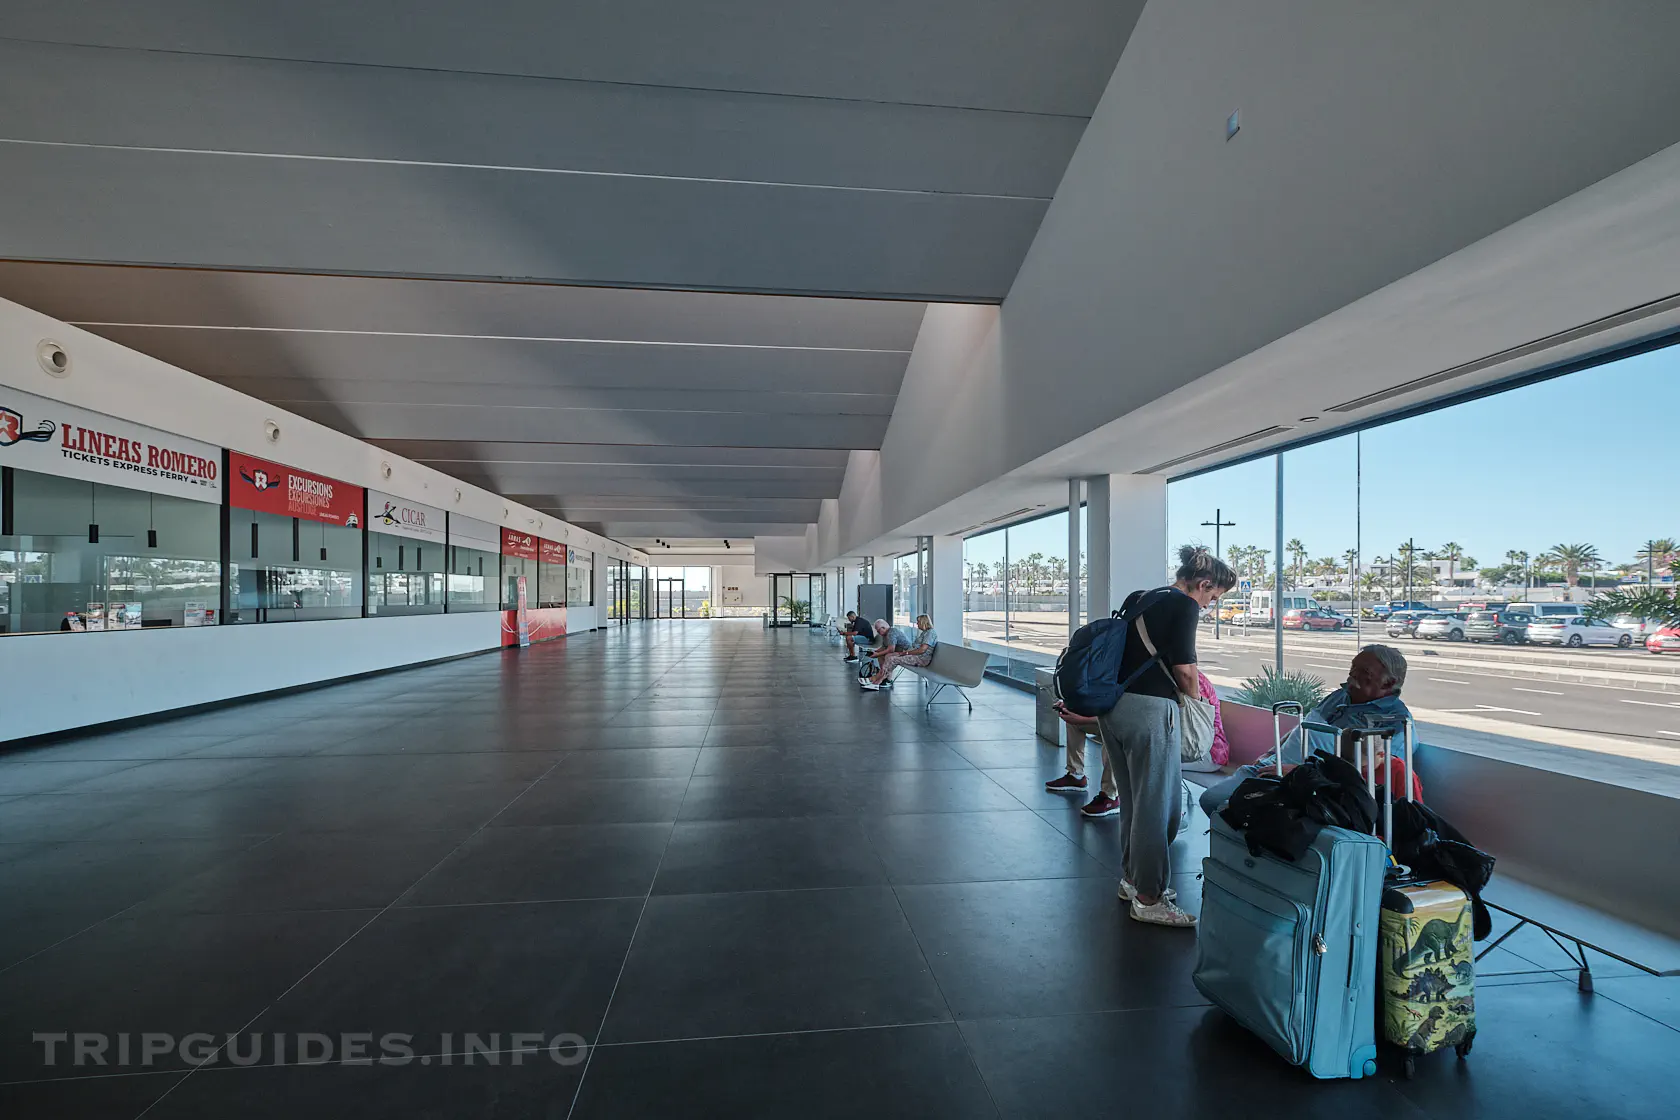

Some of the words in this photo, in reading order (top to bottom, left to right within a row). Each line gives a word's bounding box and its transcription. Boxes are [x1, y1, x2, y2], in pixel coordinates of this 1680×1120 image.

[61, 423, 142, 464] LINEAS
[147, 444, 217, 481] ROMERO
[61, 449, 110, 467] TICKETS
[113, 460, 158, 476] EXPRESS
[160, 470, 189, 483] FERRY
[288, 474, 333, 499] EXCURSIONS
[401, 507, 426, 527] CICAR
